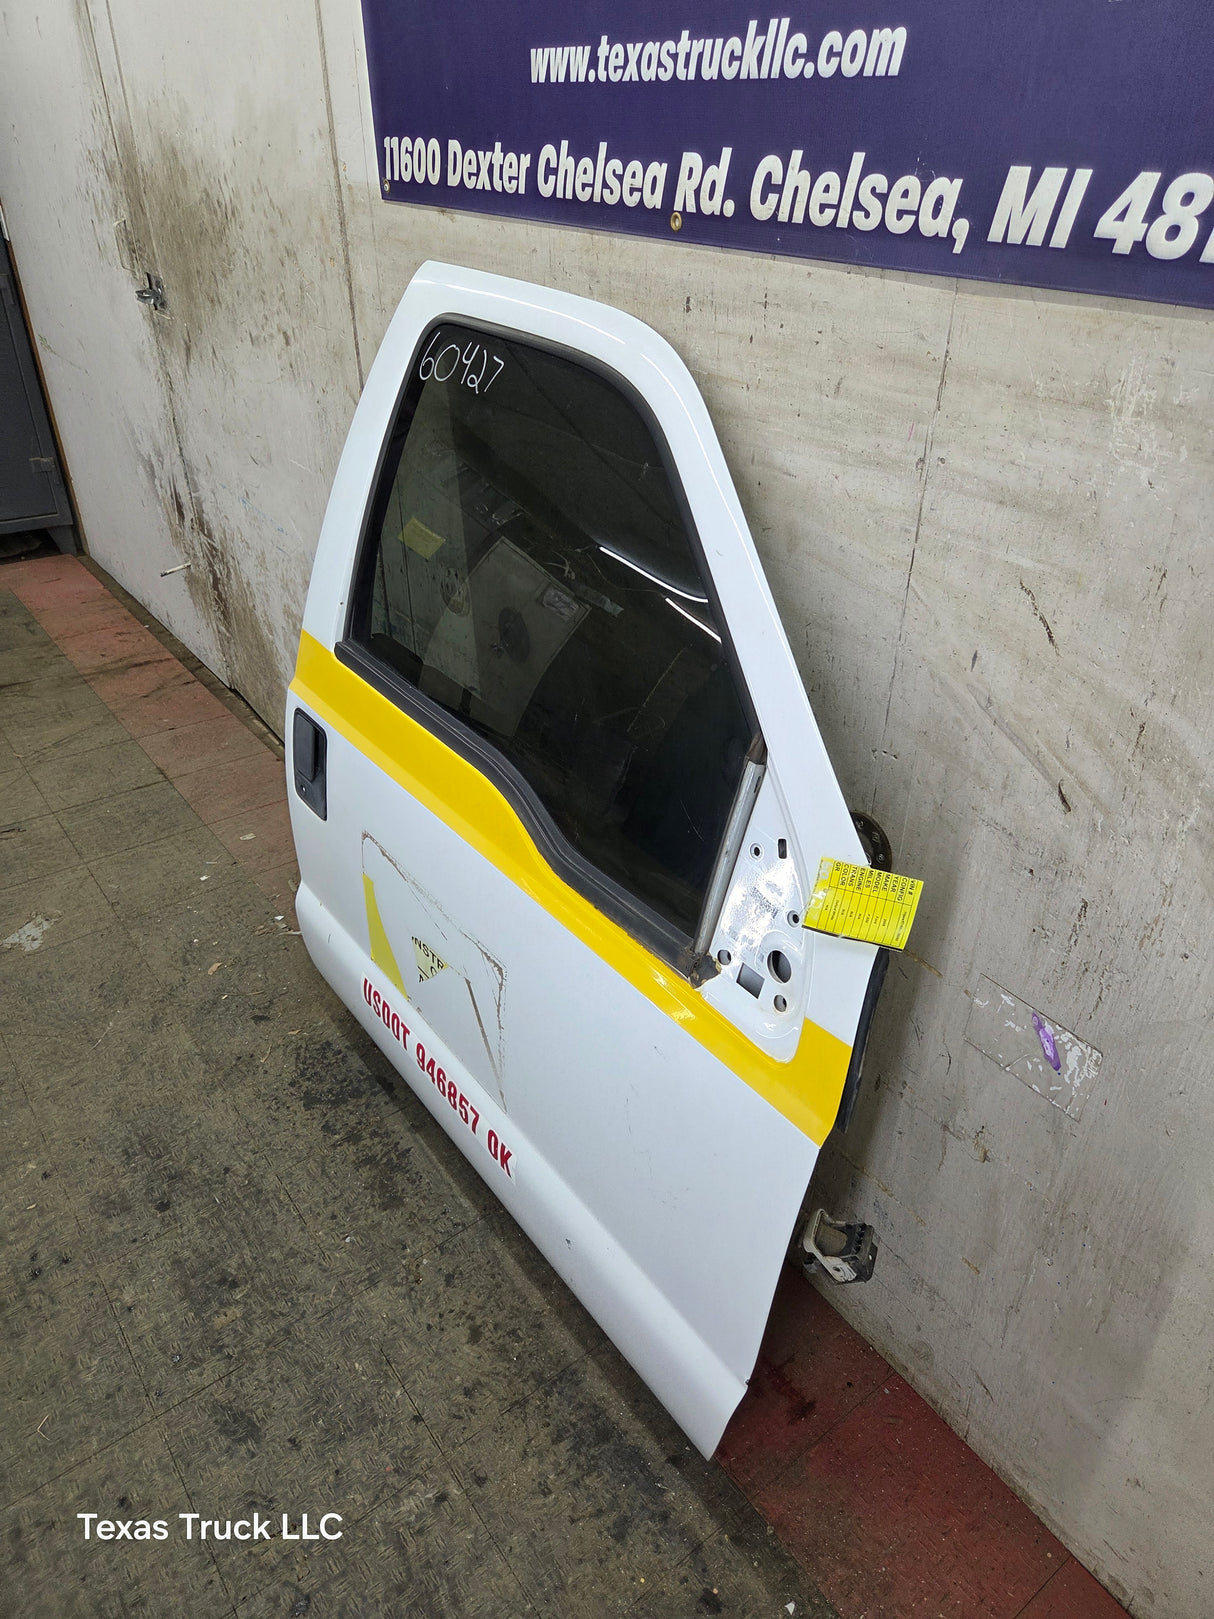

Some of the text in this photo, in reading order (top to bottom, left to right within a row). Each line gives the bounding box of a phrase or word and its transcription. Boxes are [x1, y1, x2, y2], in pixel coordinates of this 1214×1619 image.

[530, 18, 907, 84] www.texastruckllc.com
[383, 136, 1214, 264] 11600 Dexter Chelsea Rd. Chelsea, MI 48
[419, 331, 504, 394] 60427
[839, 863, 850, 886] COLOR
[847, 866, 858, 887] TRANS
[855, 867, 866, 890] ENGINE
[864, 869, 874, 888] MILES
[872, 871, 883, 893] MODEL
[881, 873, 891, 891] MAKE
[890, 875, 900, 893] YEAR
[896, 877, 908, 901] CONFIG
[363, 977, 411, 1051] USDOT
[415, 1042, 480, 1135] 946857
